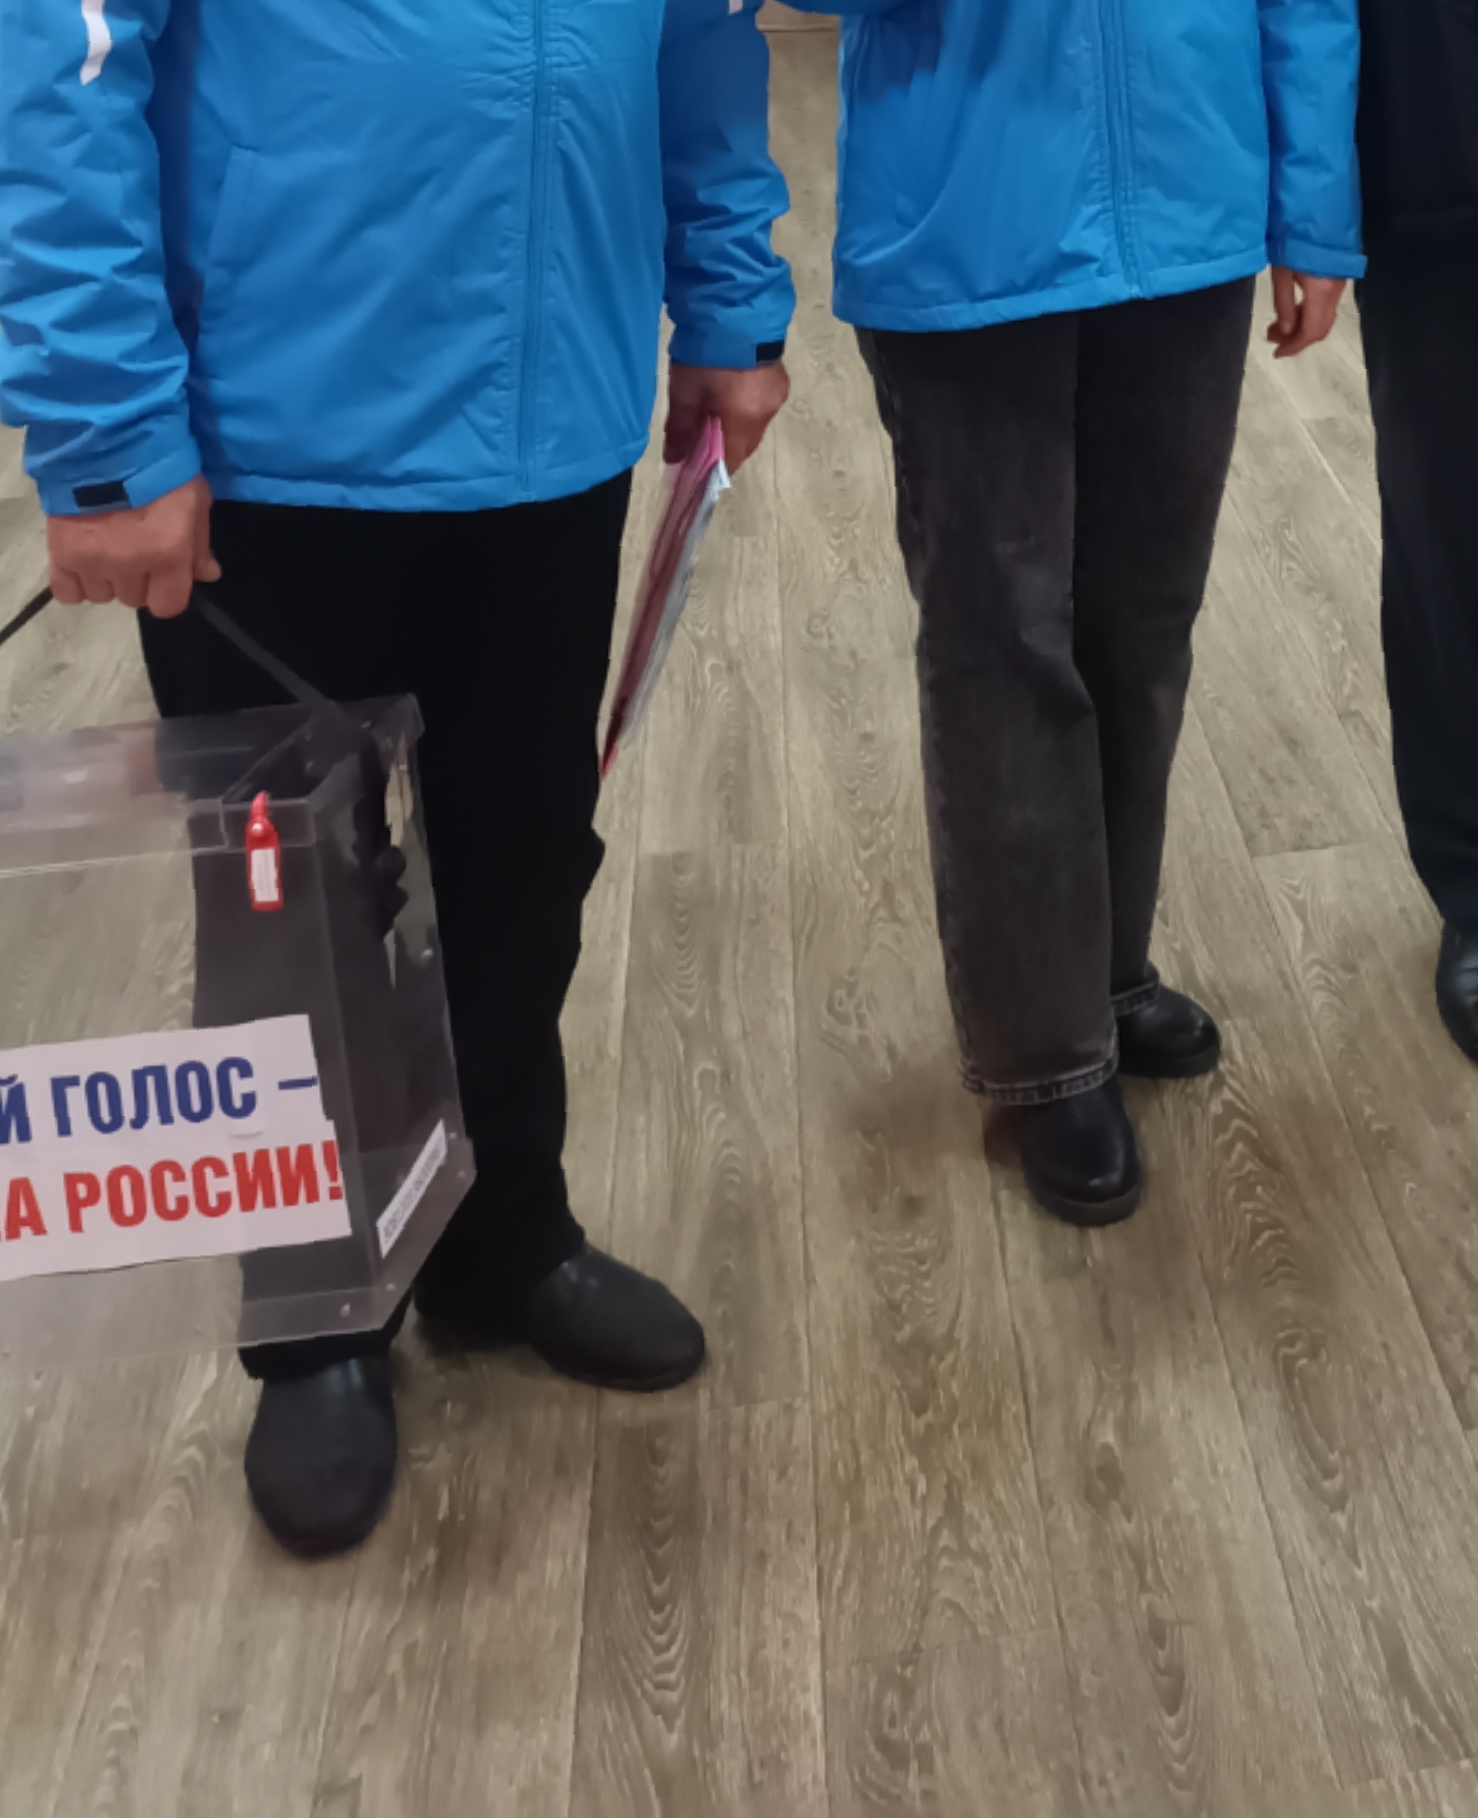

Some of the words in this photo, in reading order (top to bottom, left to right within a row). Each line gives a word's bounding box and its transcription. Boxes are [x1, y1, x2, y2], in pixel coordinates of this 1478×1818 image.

[51, 1056, 257, 1138] ГОЛОС
[0, 1177, 48, 1242] А
[63, 1140, 344, 1234] РОССИИ!
